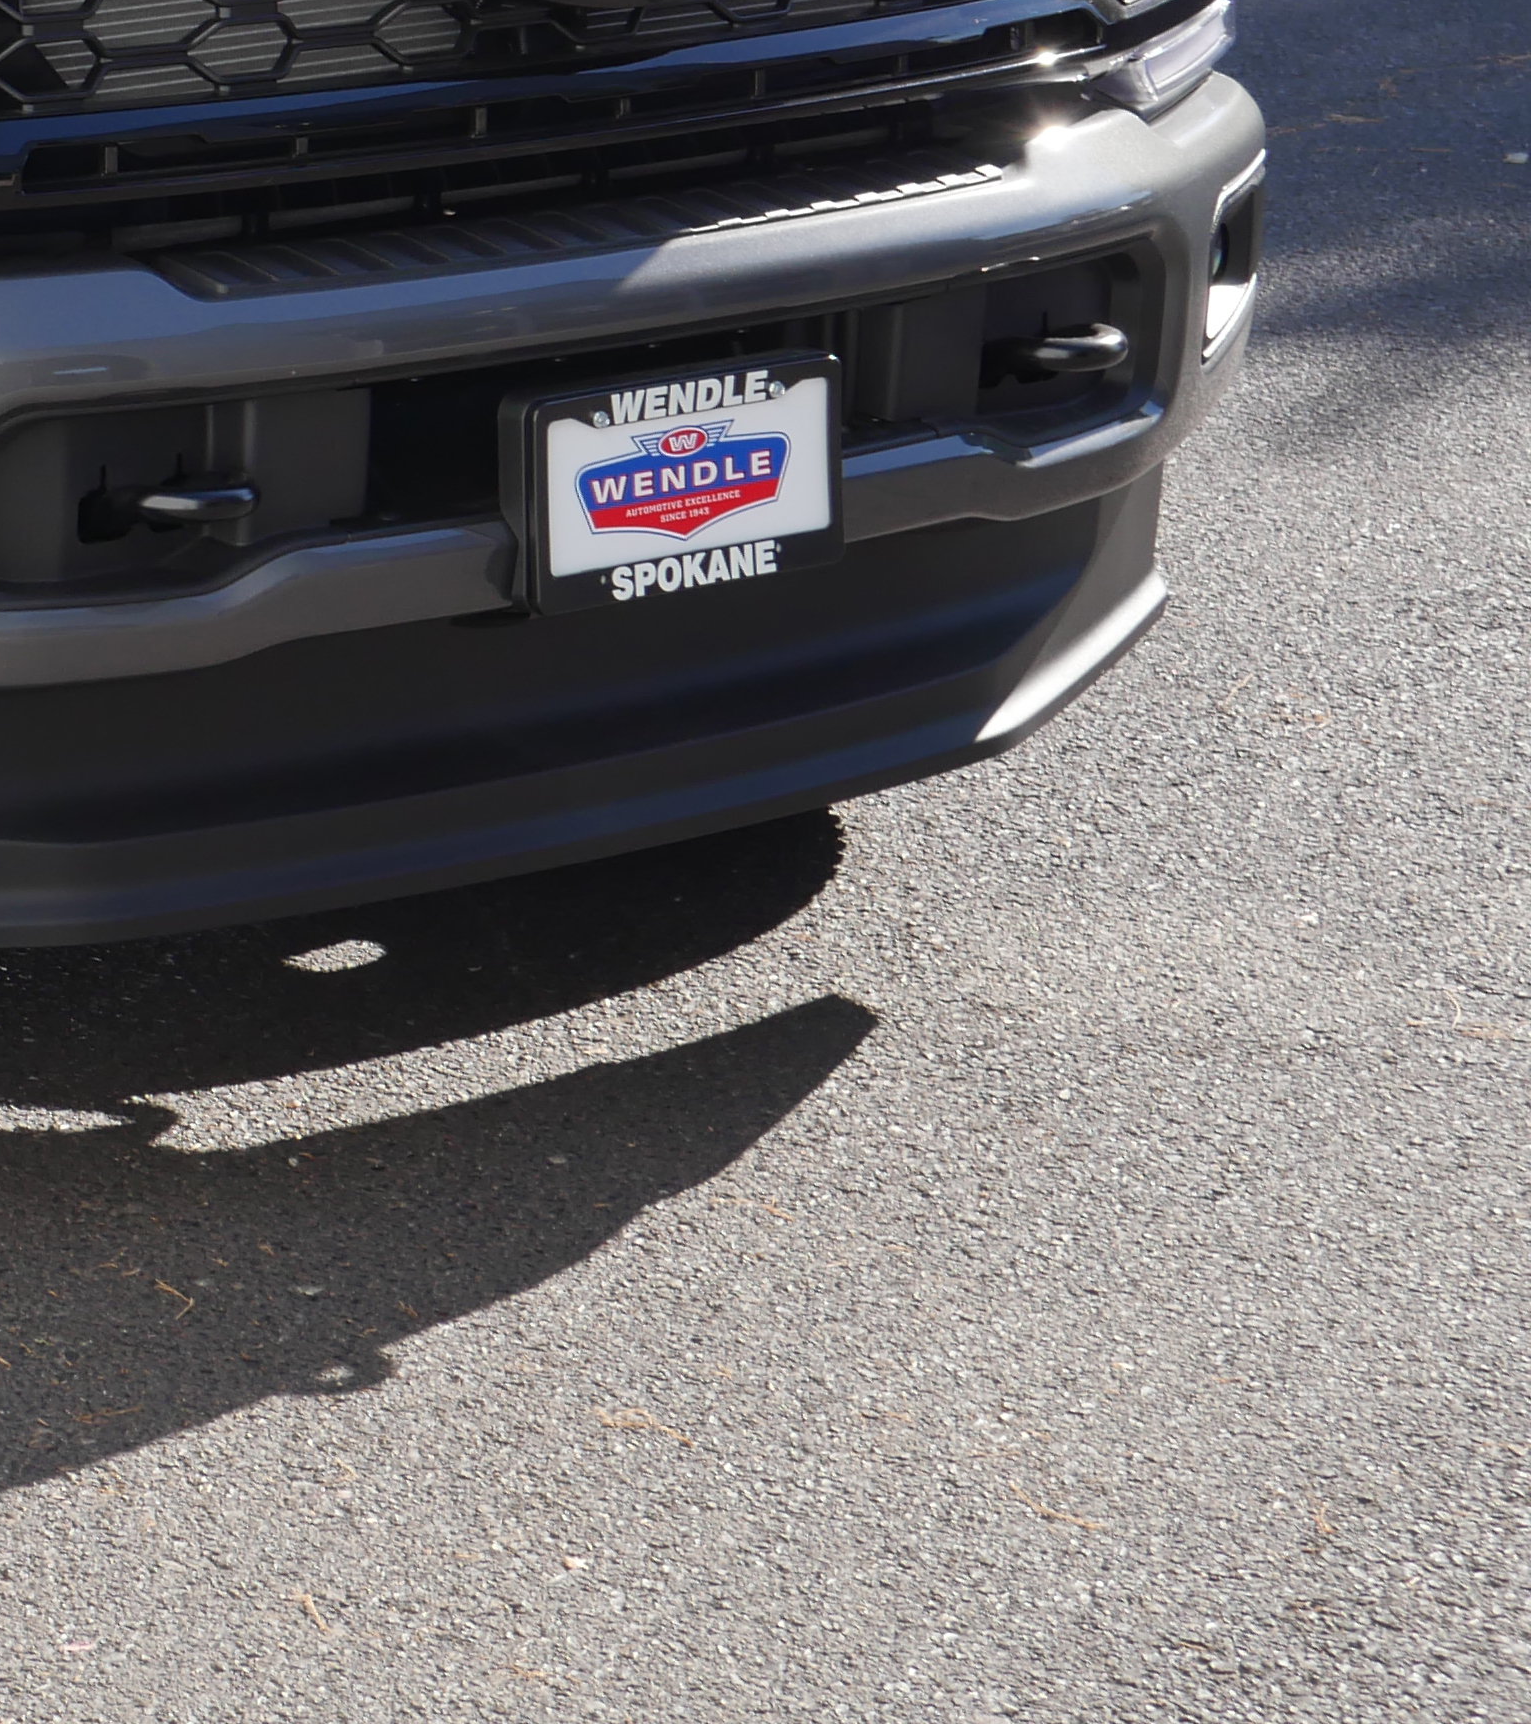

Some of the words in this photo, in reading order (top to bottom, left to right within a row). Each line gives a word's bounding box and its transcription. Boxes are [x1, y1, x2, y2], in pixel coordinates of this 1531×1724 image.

[610, 370, 768, 425] WENDLE
[668, 433, 697, 452] W
[591, 450, 771, 504] WENDLE
[625, 499, 683, 518] AUTOMOTIVE
[684, 489, 741, 508] EXCELLENCE
[660, 510, 687, 524] SINCE
[612, 540, 777, 601] SPOKANE
